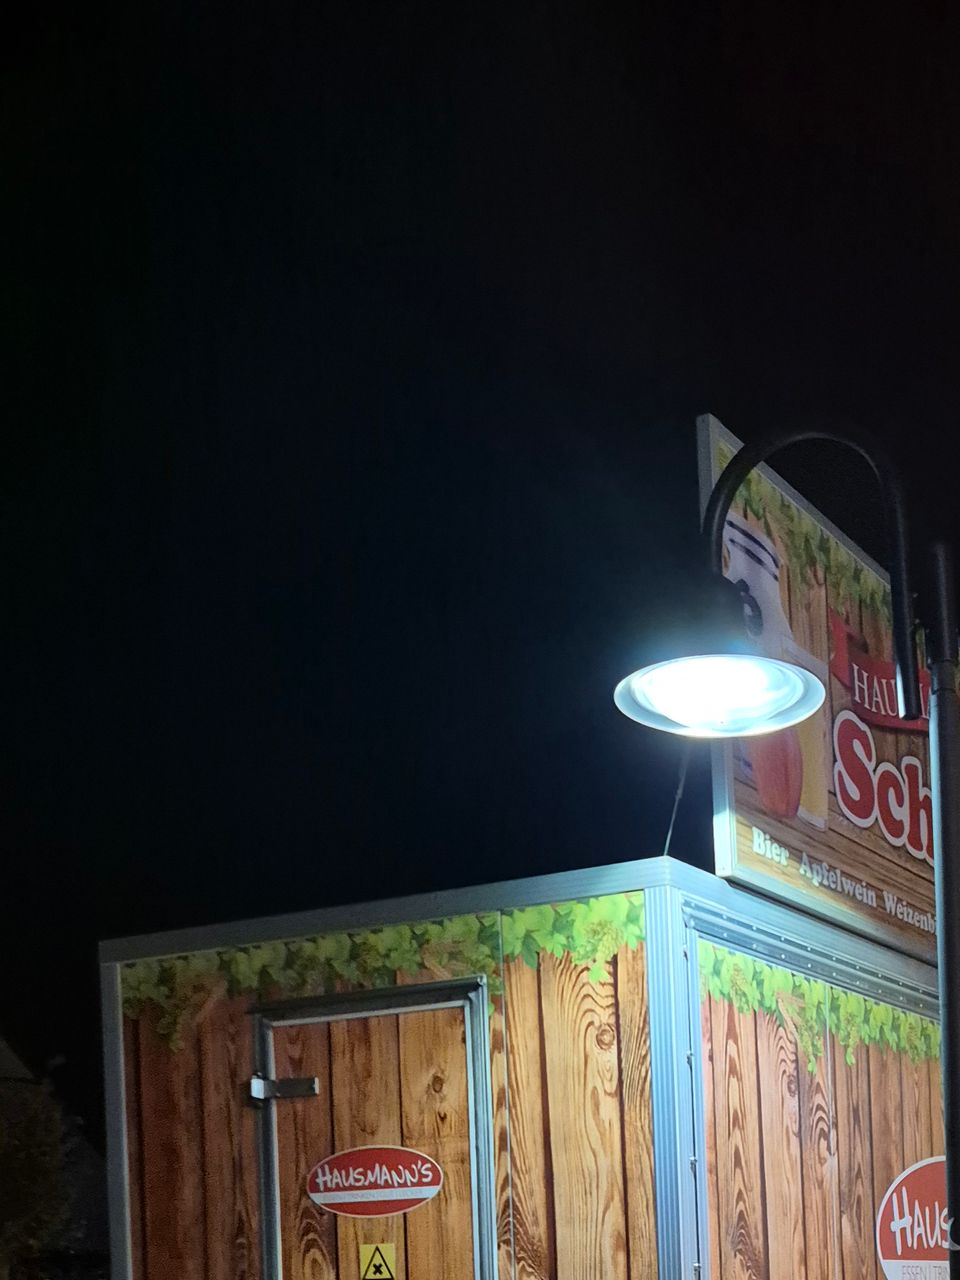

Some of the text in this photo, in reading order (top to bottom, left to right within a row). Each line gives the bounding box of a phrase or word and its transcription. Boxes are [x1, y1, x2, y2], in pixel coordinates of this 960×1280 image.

[751, 825, 790, 867] Bier
[799, 851, 877, 907] Apfelwein
[883, 890, 937, 935] Weizenb
[315, 1160, 433, 1192] HAUSMANN'S
